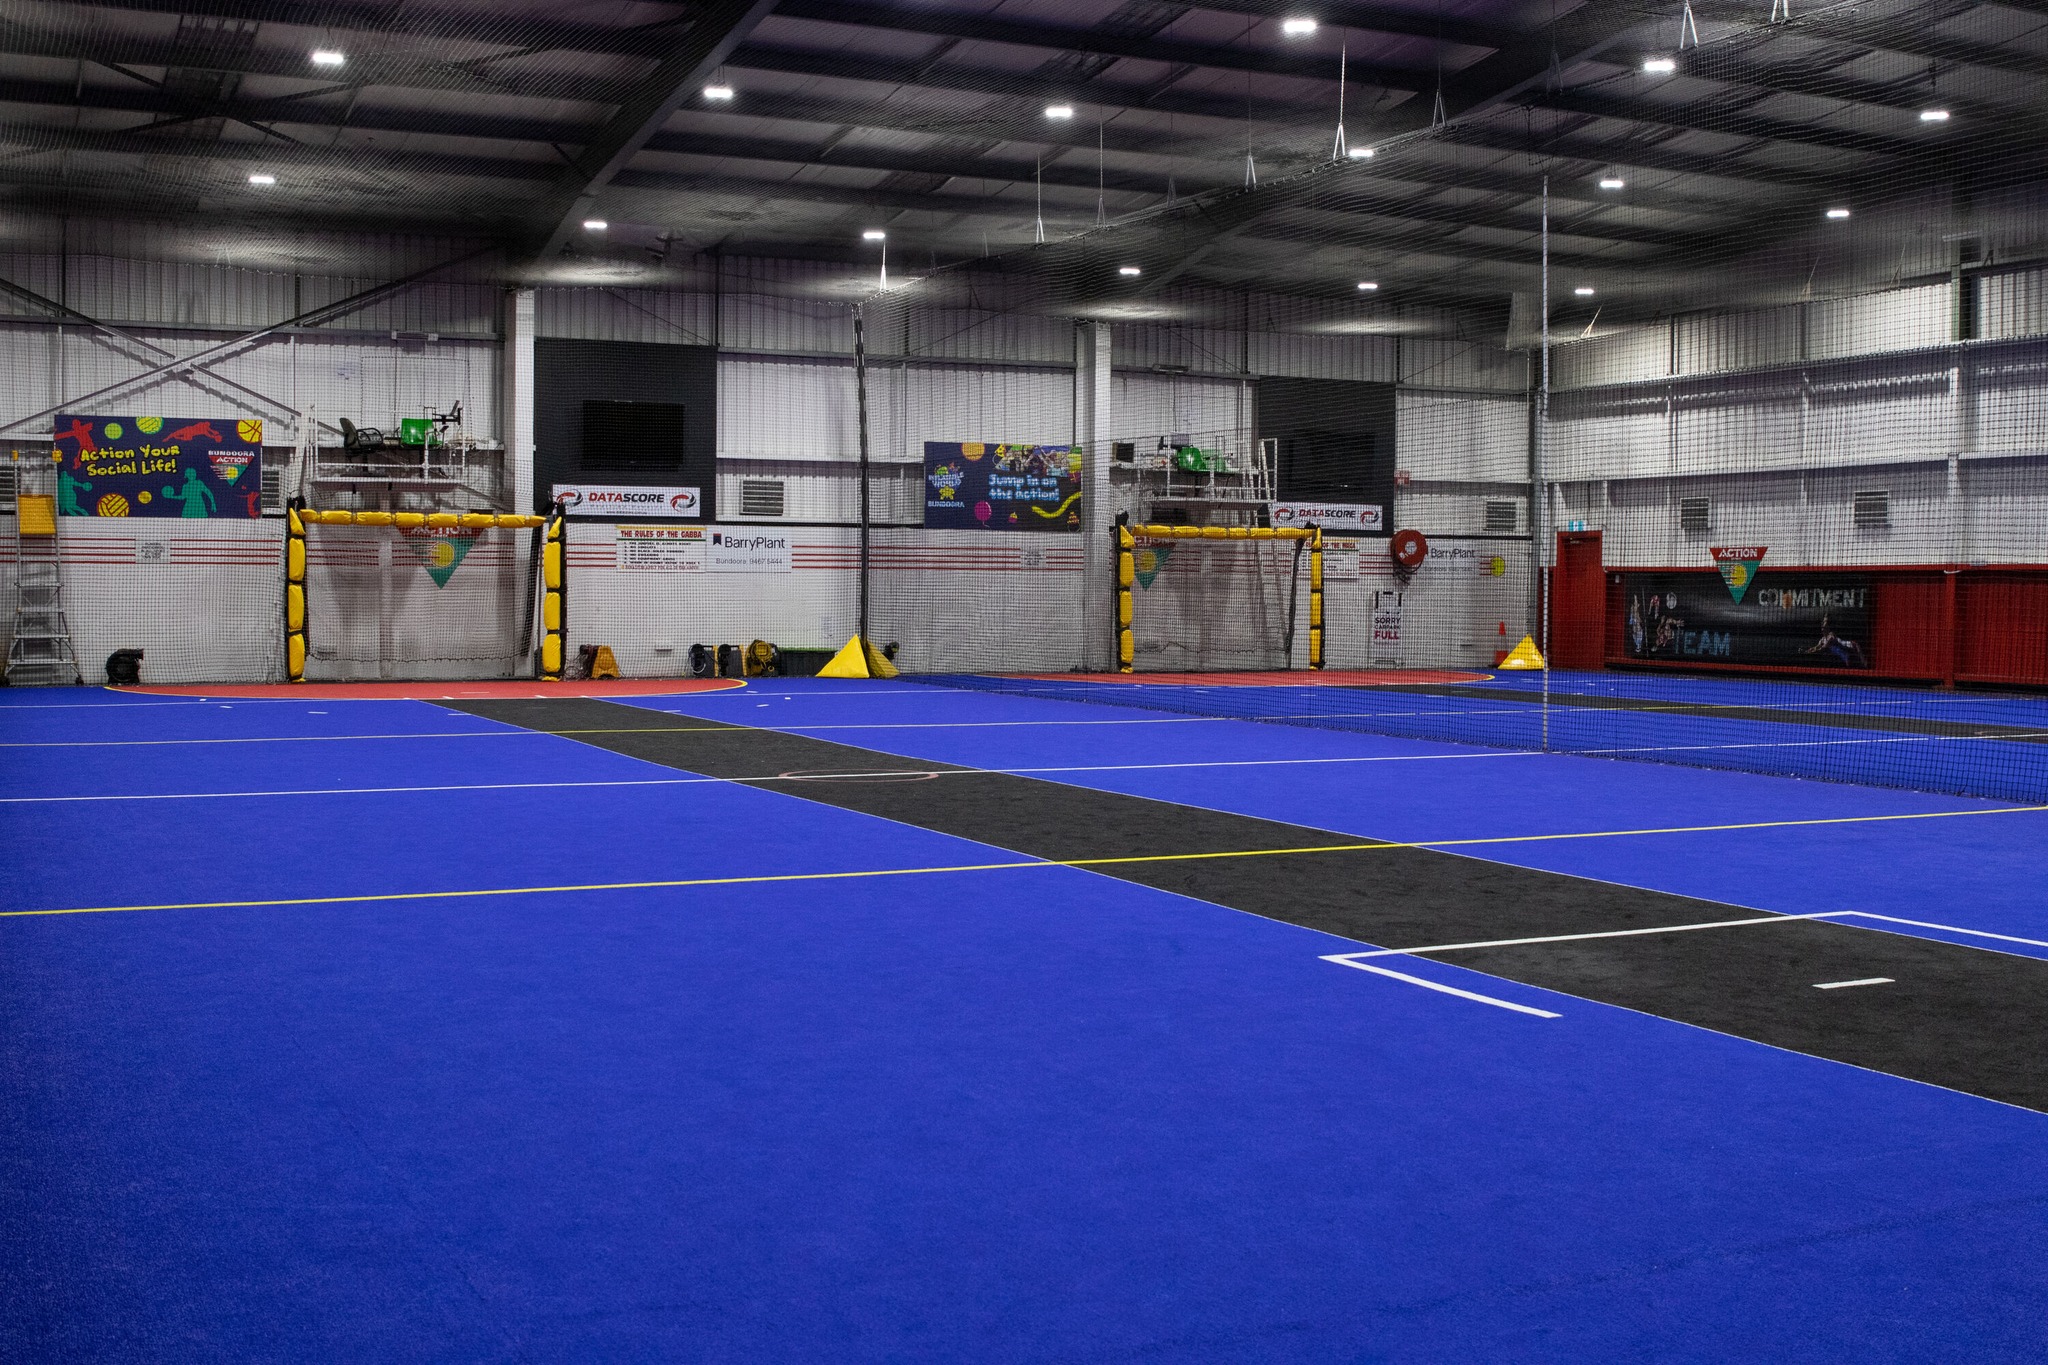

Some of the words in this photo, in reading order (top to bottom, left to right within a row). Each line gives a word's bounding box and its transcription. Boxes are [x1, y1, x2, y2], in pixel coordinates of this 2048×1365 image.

[81, 446, 135, 461] Action
[86, 460, 137, 476] Social
[141, 459, 177, 475] Life!
[989, 474, 1024, 490] Jump
[1026, 474, 1040, 486] in
[1041, 477, 1057, 487] on
[589, 492, 665, 503] DATASCORE
[989, 488, 1012, 500] the
[1015, 488, 1060, 501] action!
[1299, 509, 1356, 518] DATASCORE
[621, 530, 633, 538] THE
[635, 530, 654, 538] RULES
[656, 530, 665, 538] OF
[667, 530, 679, 538] THE
[681, 531, 702, 539] GABBA
[725, 536, 786, 551] BarryPlant
[1431, 548, 1474, 560] BarryPlant
[1718, 548, 1758, 558] ACTION
[1375, 630, 1400, 640] FULL
[1673, 629, 1731, 657] TEAM
